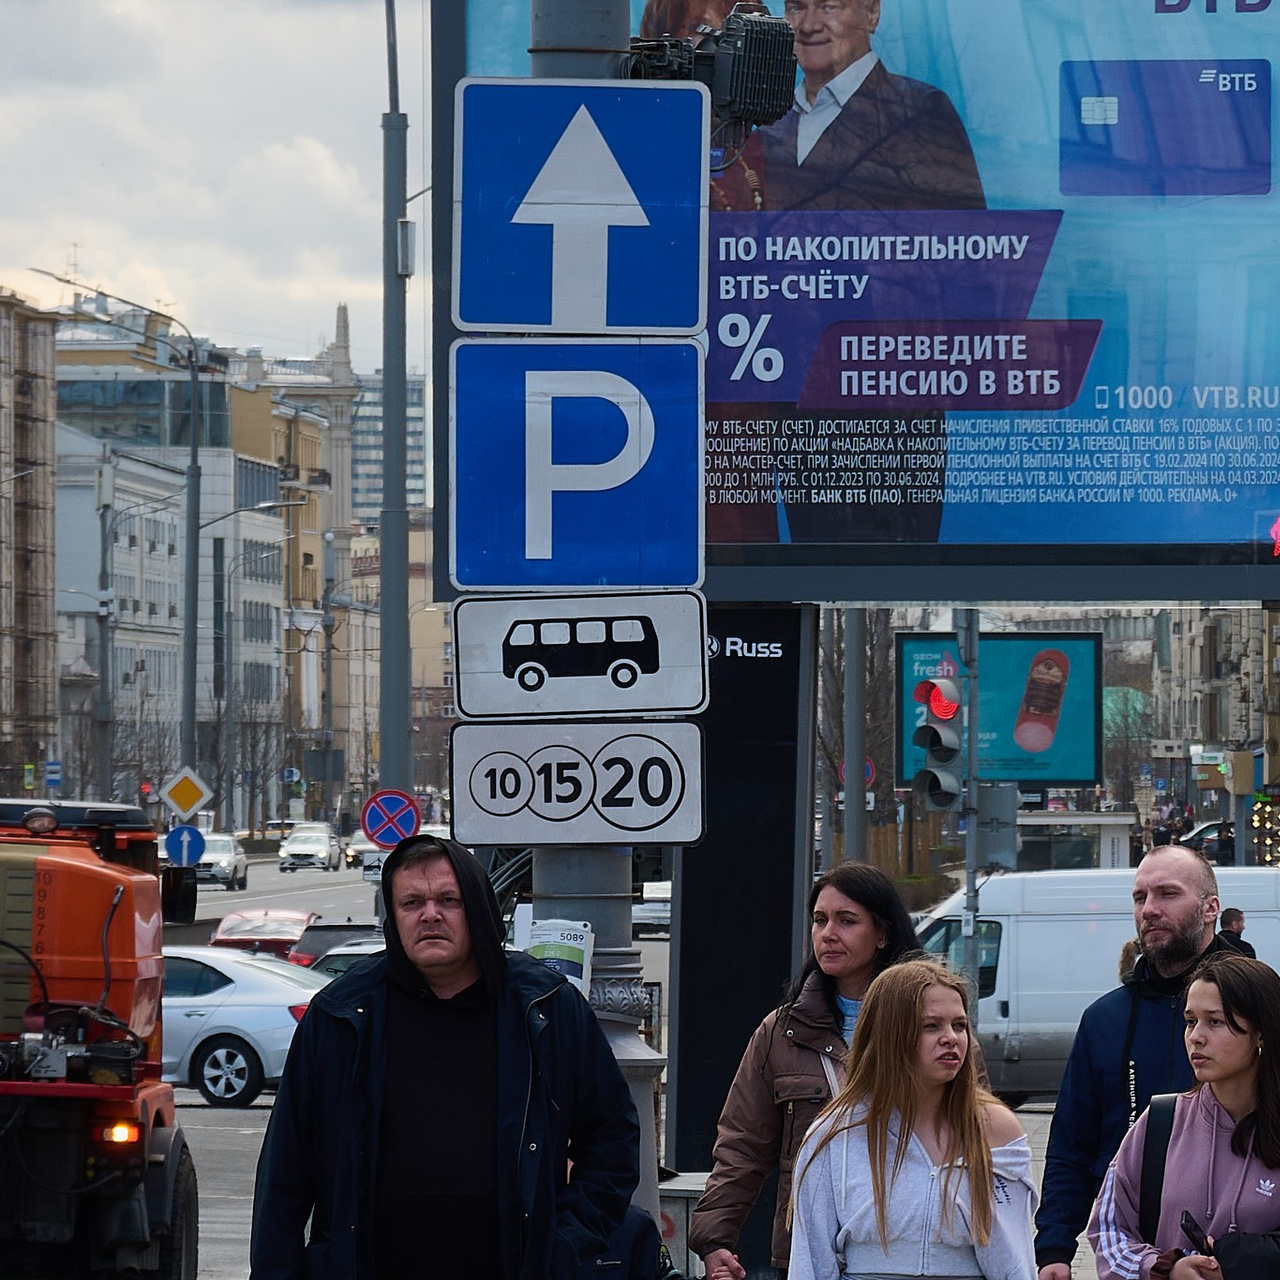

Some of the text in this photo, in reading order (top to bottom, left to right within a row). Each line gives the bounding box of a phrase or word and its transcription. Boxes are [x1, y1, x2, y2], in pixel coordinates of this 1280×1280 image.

[1218, 73, 1257, 92] ВТБ
[719, 234, 1030, 262] ПО НАКОПИТЕЛЬНОМУ
[719, 269, 870, 300] ВТБ-СЧЁТУ
[840, 335, 1028, 366] ПЕРЕВЕДИТЕ
[840, 370, 1061, 396] ПЕНСИЮ В ВТБ
[1114, 385, 1173, 410] 1000
[1193, 385, 1280, 409] VTB.RU
[723, 420, 778, 435] ВТБ-СЧЕТУ
[781, 420, 814, 437] (СЧЕТ)
[818, 420, 890, 437] ДОСТИГАЕТСЯ
[893, 419, 908, 434] ЗА
[911, 419, 936, 434] СЧЕТ
[940, 419, 1010, 434] НАЧИСЛЕНИЯ
[1014, 416, 1109, 434] ПРИВЕТСТВЕННОЙ
[1112, 419, 1154, 434] СТАВКИ
[1159, 419, 1179, 433] 16%
[1182, 419, 1232, 435] ГОДОВЫХ
[1236, 419, 1243, 433] С
[1248, 419, 1252, 433] 1
[1257, 418, 1273, 433] ПО
[773, 438, 789, 452] ПО
[791, 438, 829, 454] АКЦИИ
[831, 437, 895, 454] «НАДБАВКА
[897, 437, 904, 451] К
[907, 437, 1007, 451] НАКОПИТЕЛЬНОМУ
[1009, 437, 1065, 451] ВТБ-СЧЕТУ
[1066, 437, 1081, 451] ЗА
[1083, 437, 1130, 453] ПЕРЕВОД
[1132, 436, 1175, 451] ПЕНСИИ
[1178, 436, 1185, 450] В
[1188, 436, 1212, 450] ВТБ»
[1214, 436, 1261, 452] (АКЦИЯ).
[715, 455, 730, 469] НА
[732, 455, 804, 471] МАСТЕР-СЧЕТ,
[807, 455, 828, 469] ПРИ
[831, 455, 901, 469] ЗАЧИСЛЕНИИ
[903, 451, 945, 469] ПЕРВОЙ
[947, 451, 1020, 468] ПЕНСИОННОЙ
[1022, 454, 1072, 468] ВЫПЛАТЫ
[1075, 454, 1091, 468] НА
[1093, 454, 1119, 468] СЧЕТ
[1122, 454, 1141, 468] ВТБ
[1143, 454, 1151, 468] С
[1154, 453, 1207, 468] 19.02.2024
[1210, 453, 1225, 468] ПО
[724, 472, 739, 489] ДО
[742, 472, 747, 486] 1
[751, 472, 775, 486] МЛН
[777, 472, 799, 486] РУБ.
[801, 472, 809, 486] С
[810, 472, 863, 486] 01.12.2023
[866, 472, 881, 486] ПО
[884, 472, 942, 486] 30.06.2024.
[945, 472, 1006, 487] ПОДРОБНЕЕ
[1008, 471, 1023, 486] НА
[1025, 471, 1065, 485] VTB.RU.
[1067, 471, 1117, 486] УСЛОВИЯ
[1119, 468, 1209, 487] ДЕЙСТВИТЕЛЬНЫ
[1211, 471, 1226, 485] НА
[709, 490, 716, 504] В
[718, 486, 758, 504] ЛЮБОЙ
[761, 489, 808, 504] МОМЕНТ.
[811, 489, 842, 503] БАНК
[846, 489, 867, 503] ВТБ
[869, 489, 904, 505] (ПАО).
[907, 489, 979, 503] ГЕНЕРАЛЬНАЯ
[981, 489, 1037, 505] ЛИЦЕНЗИЯ
[1039, 489, 1076, 503] БАНКА
[1078, 489, 1121, 503] РОССИИ
[1123, 489, 1135, 503] №
[1138, 488, 1165, 502] 1000.
[1168, 488, 1222, 502] РЕКЛАМА.
[1224, 488, 1238, 502] 0+
[725, 637, 783, 658] Russ
[913, 661, 954, 677] fresh
[483, 756, 673, 808] 10 15 20
[34, 872, 52, 886] 10
[37, 889, 47, 903] 9
[36, 906, 45, 920] 8
[36, 924, 45, 937] 7
[560, 932, 585, 943] 5089
[35, 942, 44, 955] 6
